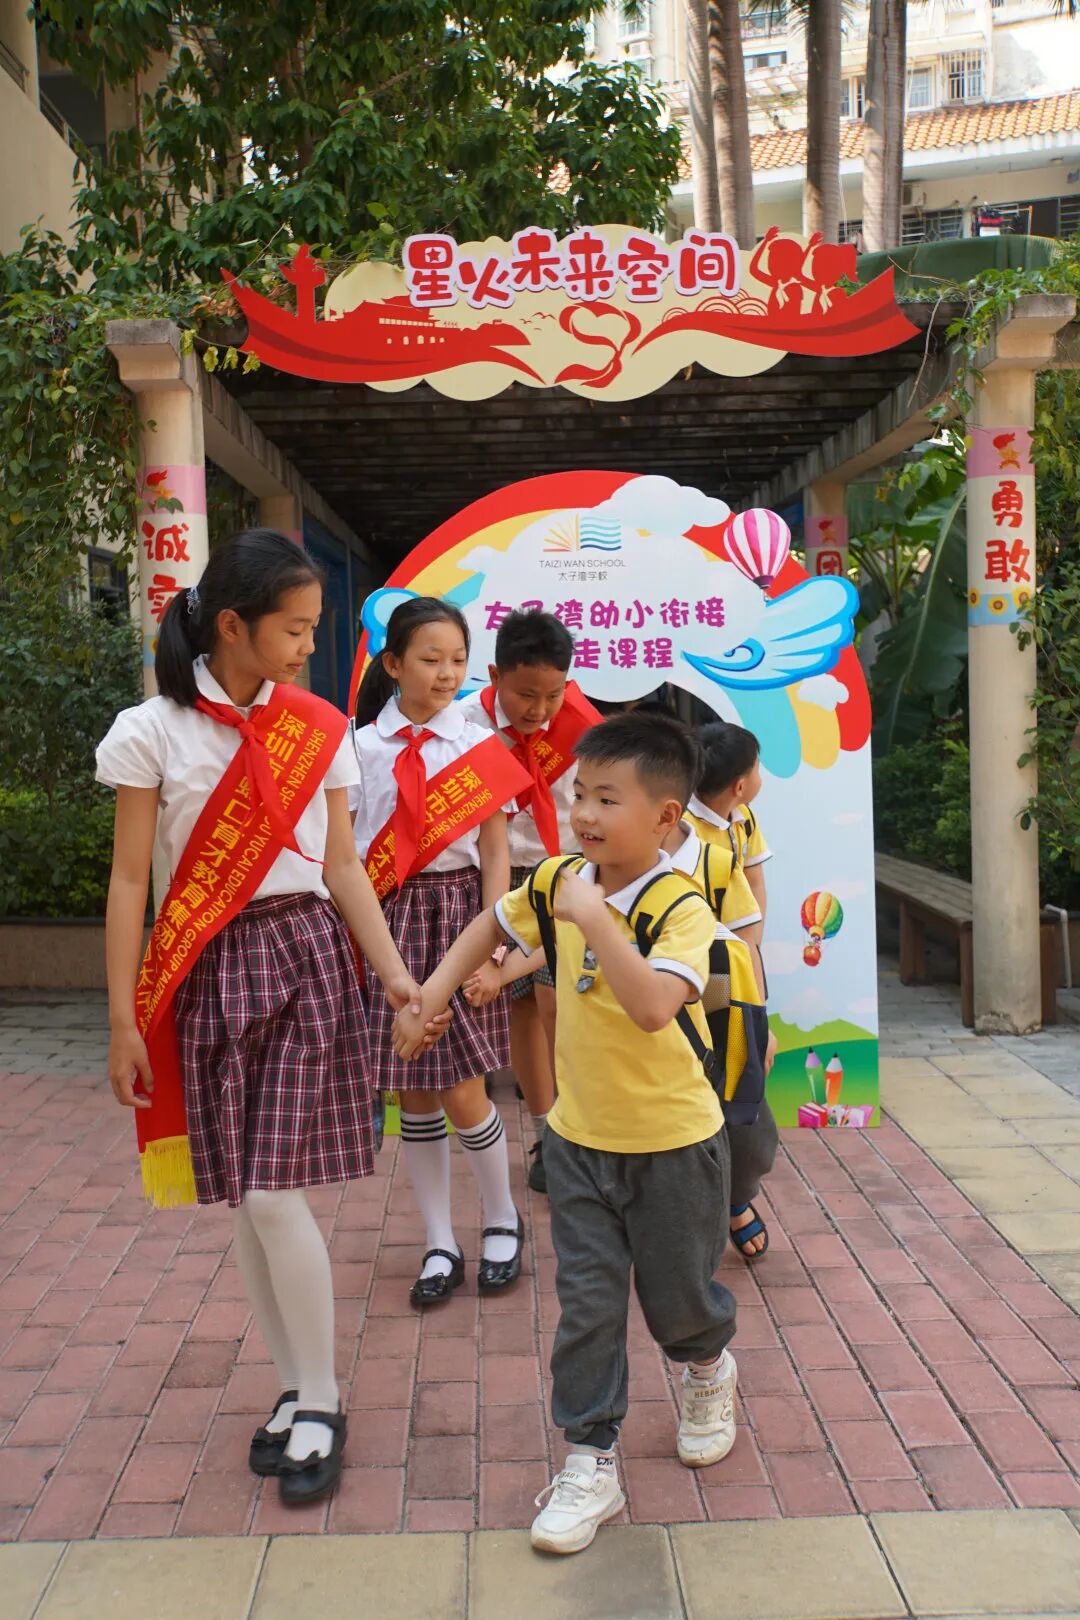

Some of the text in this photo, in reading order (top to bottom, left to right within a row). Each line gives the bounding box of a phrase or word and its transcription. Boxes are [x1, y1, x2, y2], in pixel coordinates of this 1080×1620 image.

[405, 229, 738, 305] 星火未来空间
[985, 480, 1031, 583] 勇敢
[539, 559, 627, 568] TAIZI WAN SCHOOL
[287, 728, 327, 788] SHENZHEN
[450, 787, 493, 824] SHENZHEN
[244, 831, 272, 869] YUCAI
[193, 866, 247, 931] EDUCATION
[169, 928, 197, 972] GROUP
